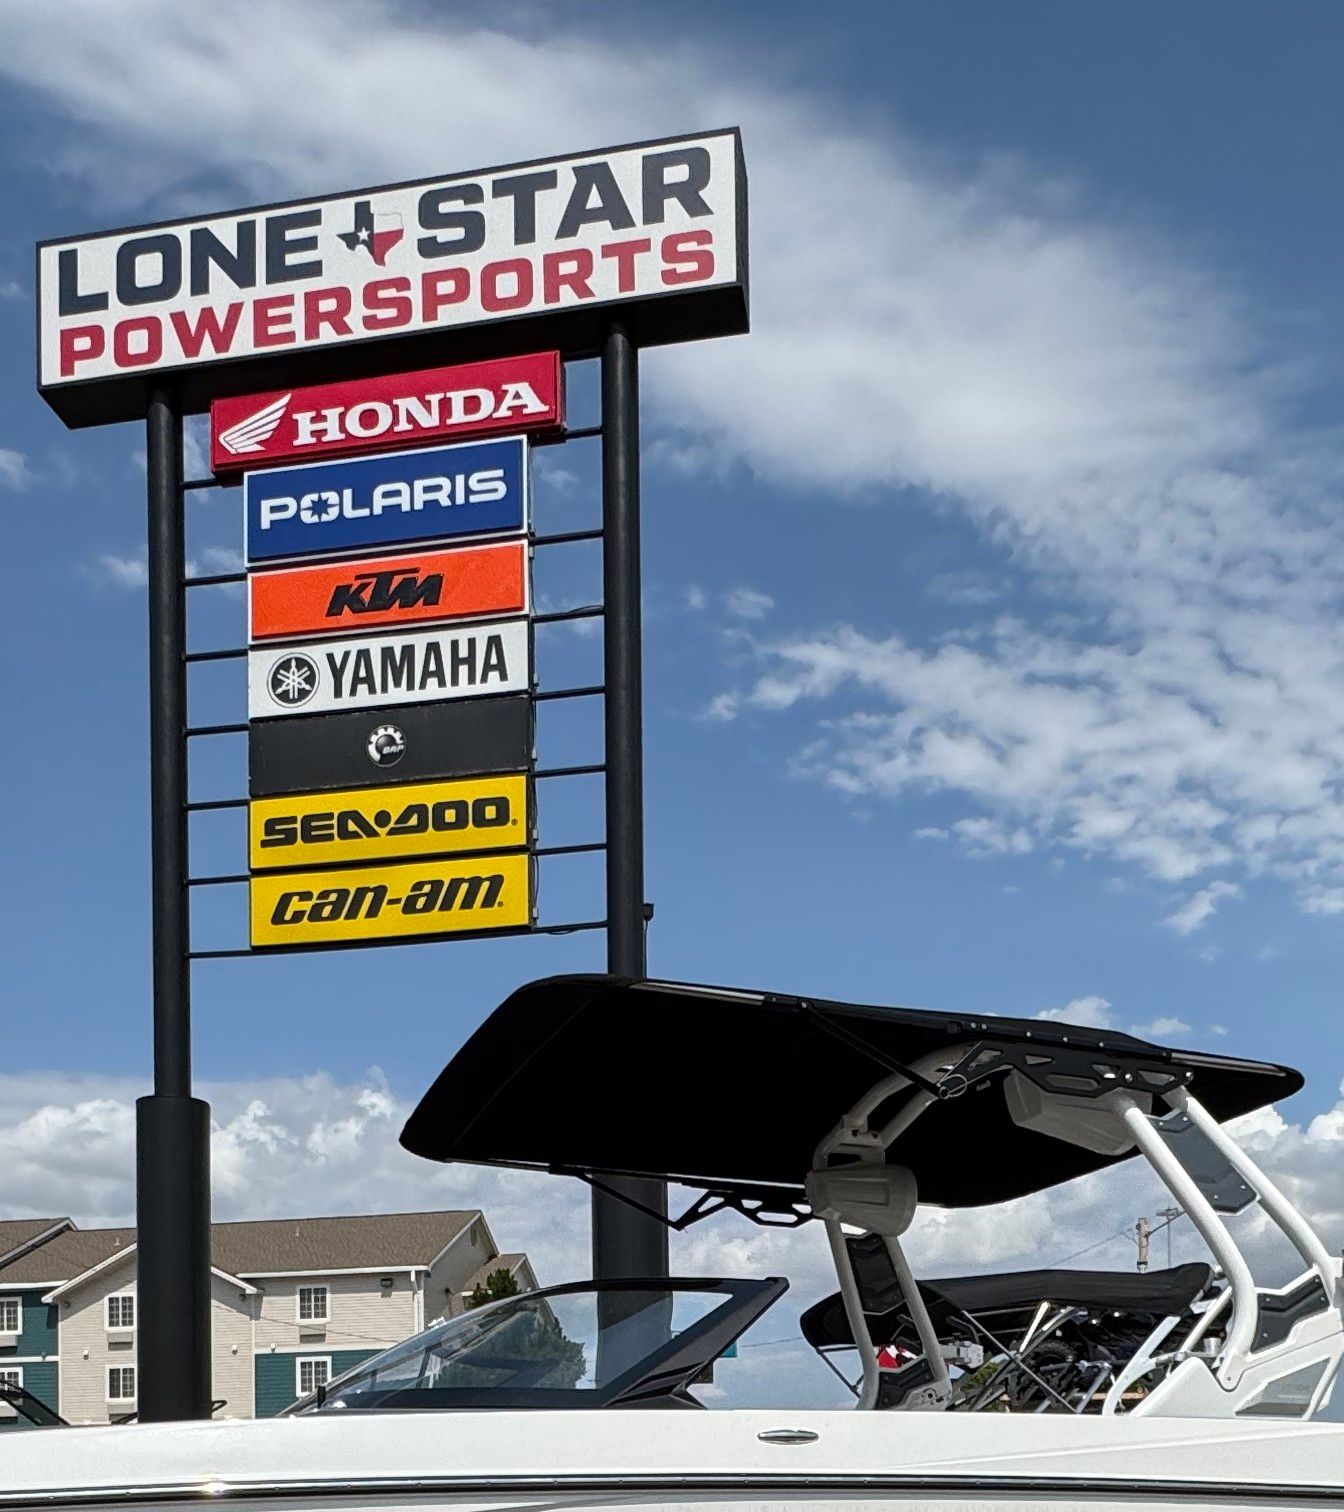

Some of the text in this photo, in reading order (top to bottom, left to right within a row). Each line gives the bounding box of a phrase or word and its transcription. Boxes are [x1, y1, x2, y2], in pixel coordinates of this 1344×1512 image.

[58, 146, 713, 317] LONE STAR
[59, 229, 716, 377] POWERSPORTS
[291, 381, 549, 447] HONDA
[259, 468, 508, 531] POLARIS
[325, 566, 444, 618] KTM
[325, 633, 510, 699] YAMAHA
